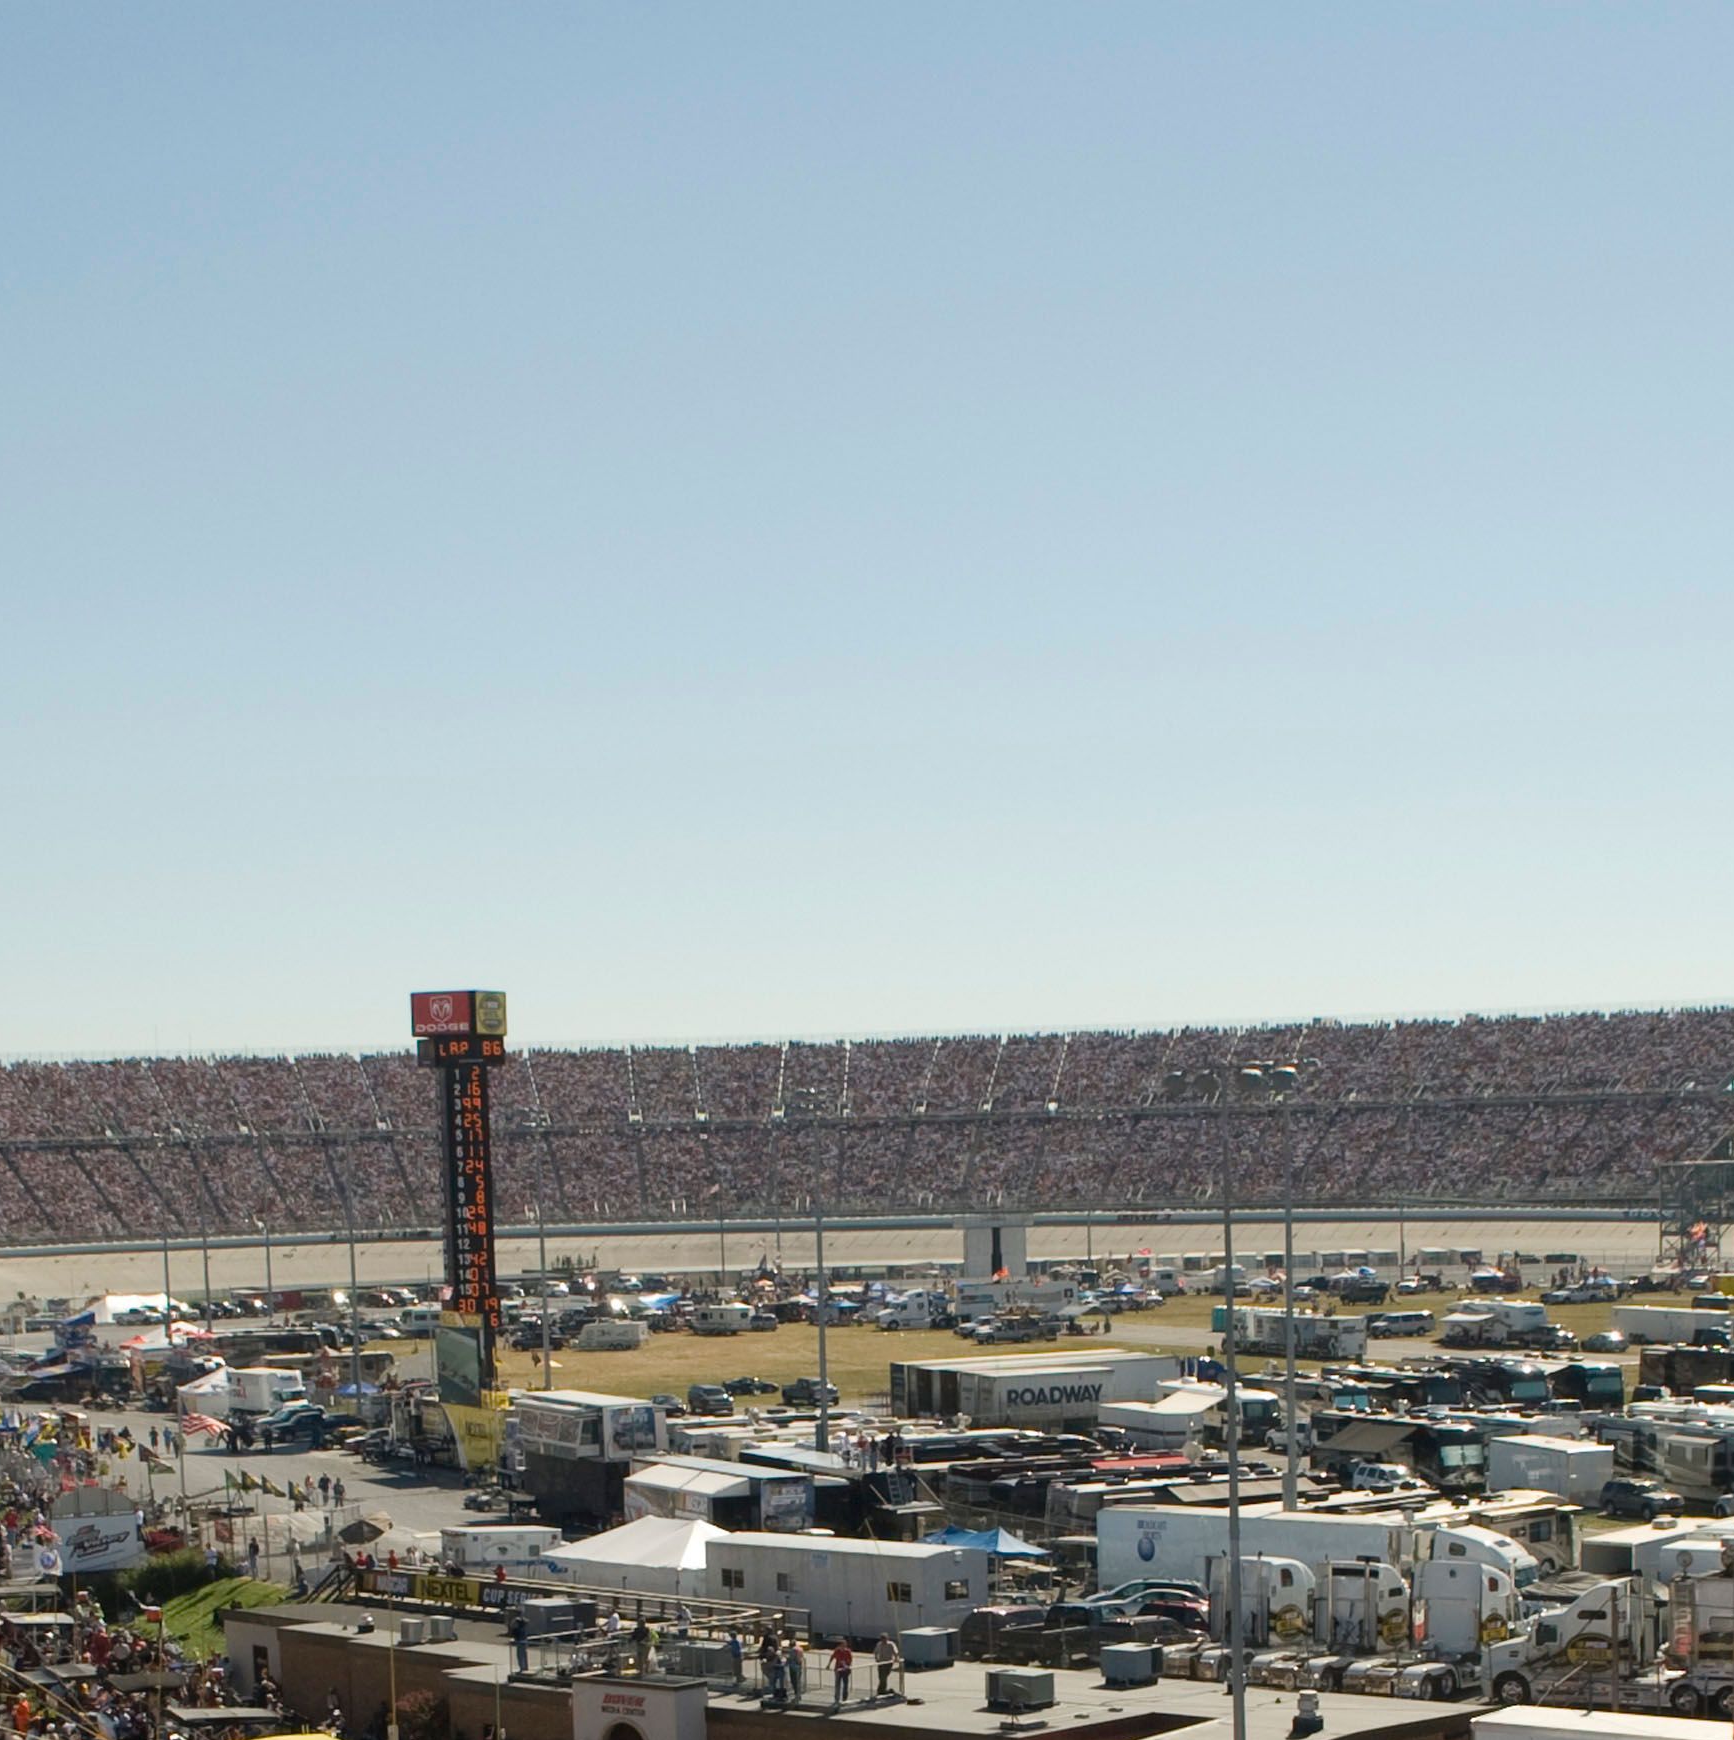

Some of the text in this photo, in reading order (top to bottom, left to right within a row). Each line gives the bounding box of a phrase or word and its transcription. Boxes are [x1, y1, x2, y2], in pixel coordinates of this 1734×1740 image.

[416, 1022, 470, 1032] DODGE
[471, 1066, 480, 1080] 2
[467, 1082, 481, 1096] 16
[466, 1160, 484, 1173] 24
[476, 1190, 485, 1204] 8
[467, 1205, 486, 1219] 29
[458, 1238, 471, 1250] 12
[470, 1251, 487, 1265] 42
[1007, 1384, 1103, 1406] ROADWAY
[421, 1579, 473, 1600] NEXTEL
[483, 1588, 505, 1603] CUP
